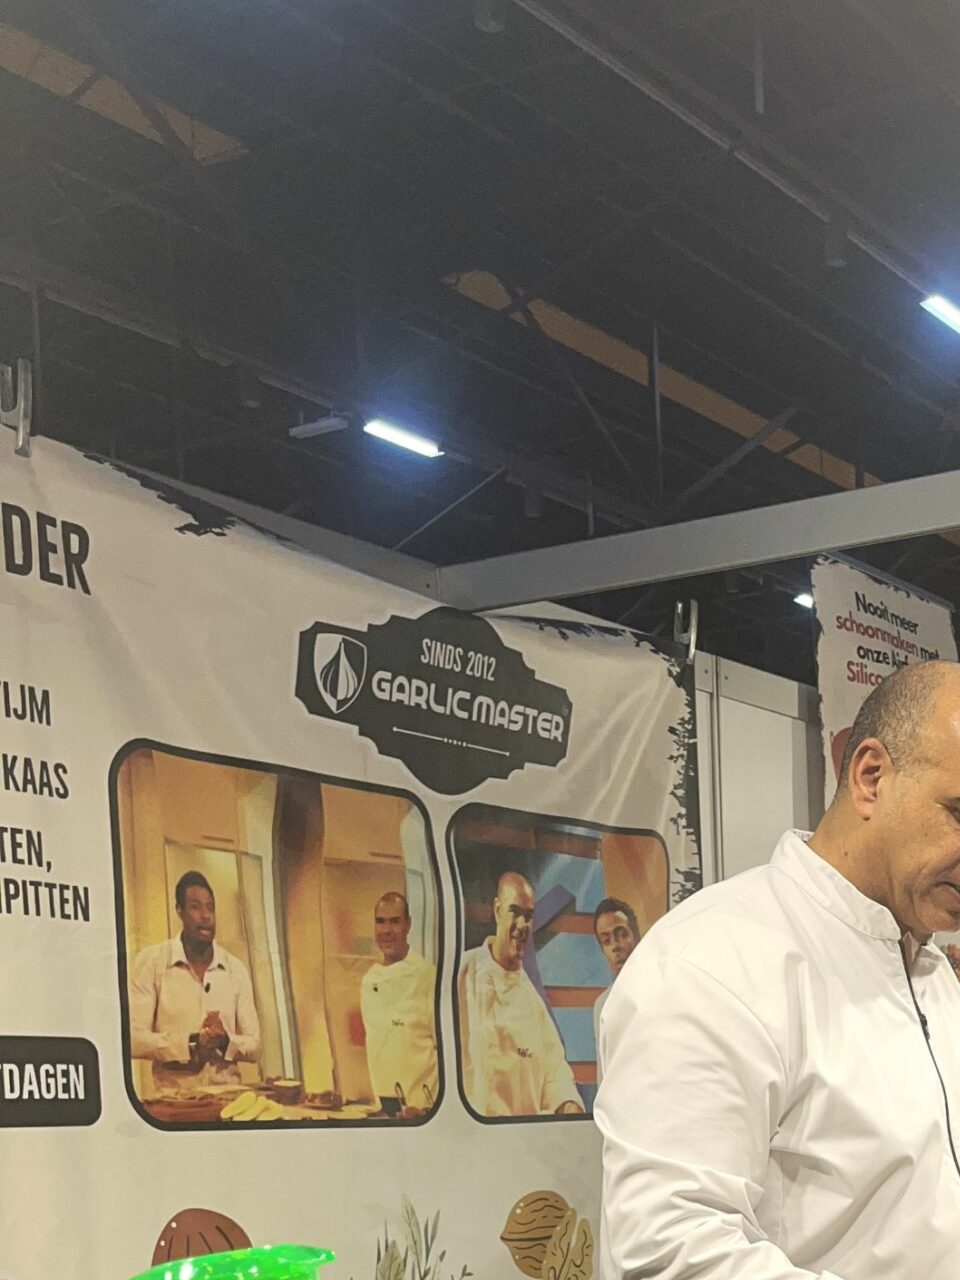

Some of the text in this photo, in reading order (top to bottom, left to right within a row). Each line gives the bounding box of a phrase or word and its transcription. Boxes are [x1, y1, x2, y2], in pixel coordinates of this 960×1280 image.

[855, 591, 891, 624] Nooit
[421, 638, 497, 682] SINDS 2012
[857, 645, 891, 665] onze
[0, 680, 52, 727] IJM
[371, 670, 565, 743] GARLICMASTER
[2, 753, 70, 800] KAAS
[0, 877, 91, 922] PITTEN
[0, 1062, 85, 1100] DAGEN
